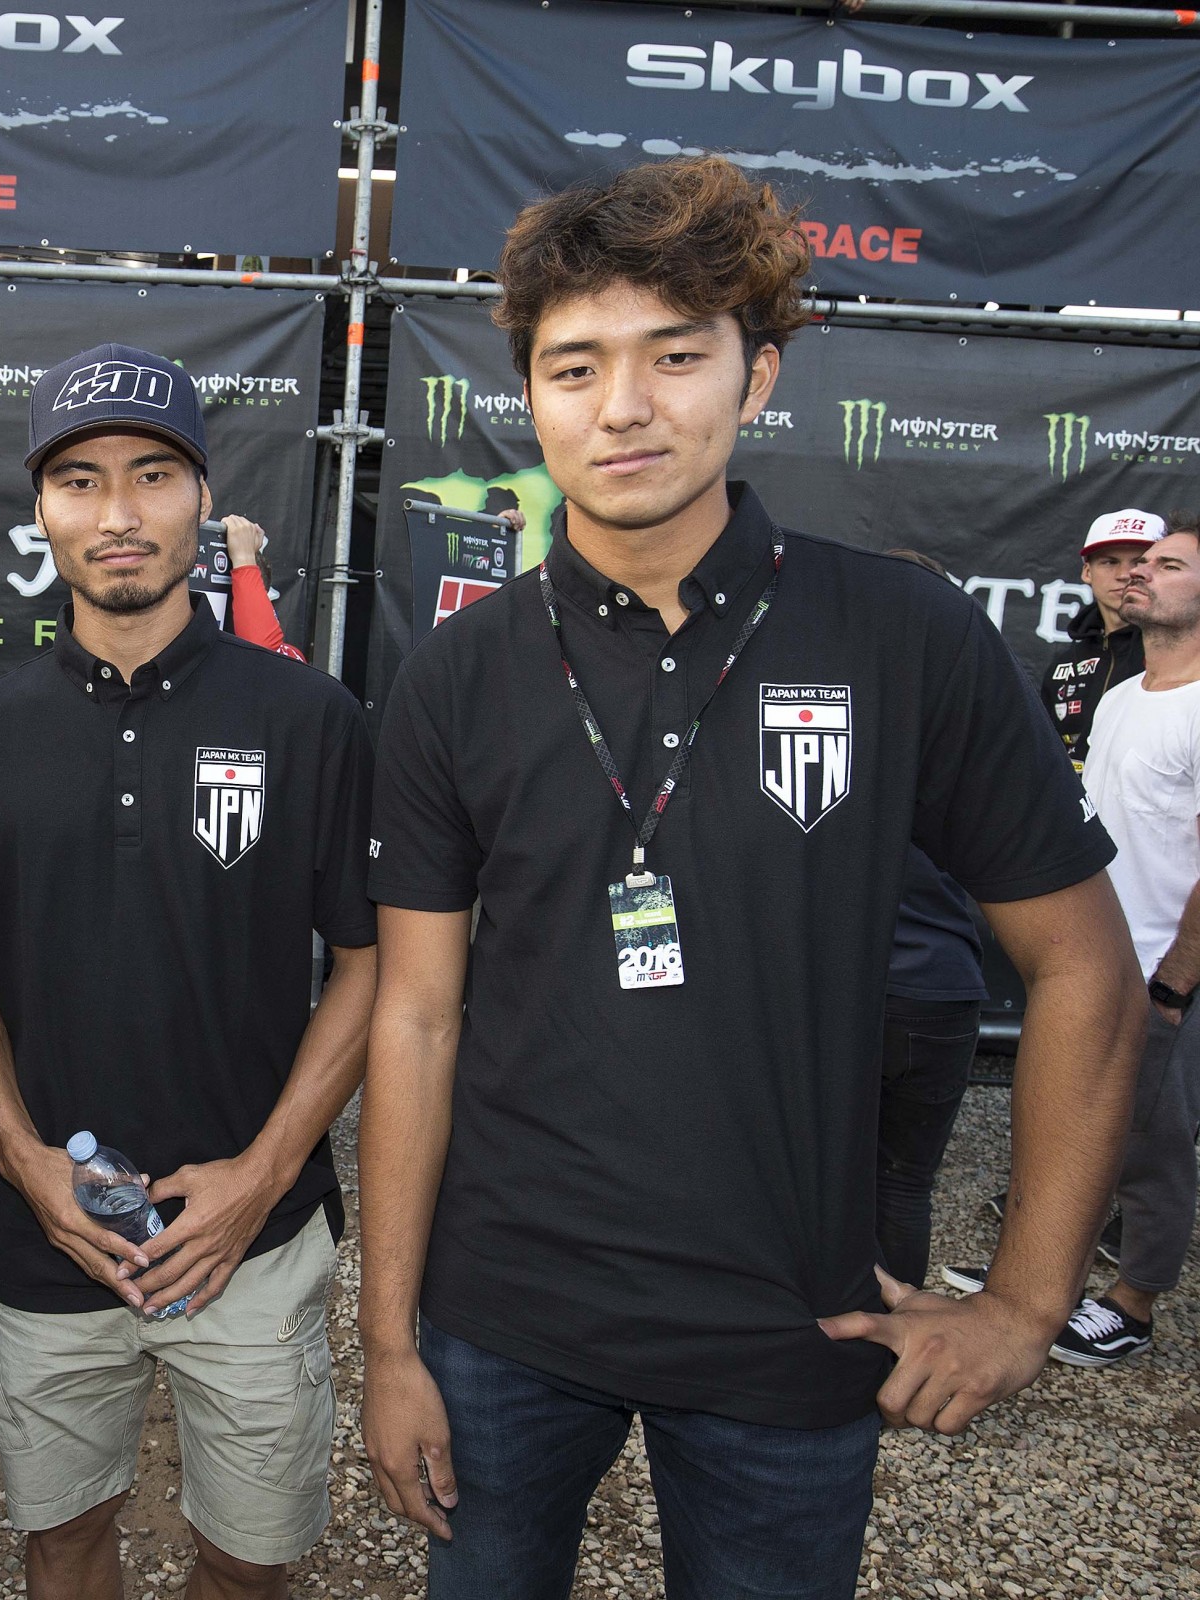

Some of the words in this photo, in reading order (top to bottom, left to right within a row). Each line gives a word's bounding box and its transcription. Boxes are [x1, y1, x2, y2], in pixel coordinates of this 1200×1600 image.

[626, 41, 1035, 112] Skybox
[190, 373, 301, 396] MONSTER
[205, 396, 284, 407] ENERGY
[890, 416, 999, 441] MONSTER
[905, 439, 981, 451] ENERGY
[1095, 430, 1200, 454] MONSTER
[1110, 452, 1186, 465] ENERGY
[765, 688, 799, 699] JAPAN
[801, 689, 817, 698] MX
[818, 689, 846, 699] TEAM
[200, 751, 226, 759] JAPAN
[241, 753, 262, 761] TEAM
[765, 734, 847, 823] JPN
[197, 788, 262, 862] JPN
[618, 943, 682, 972] 2016
